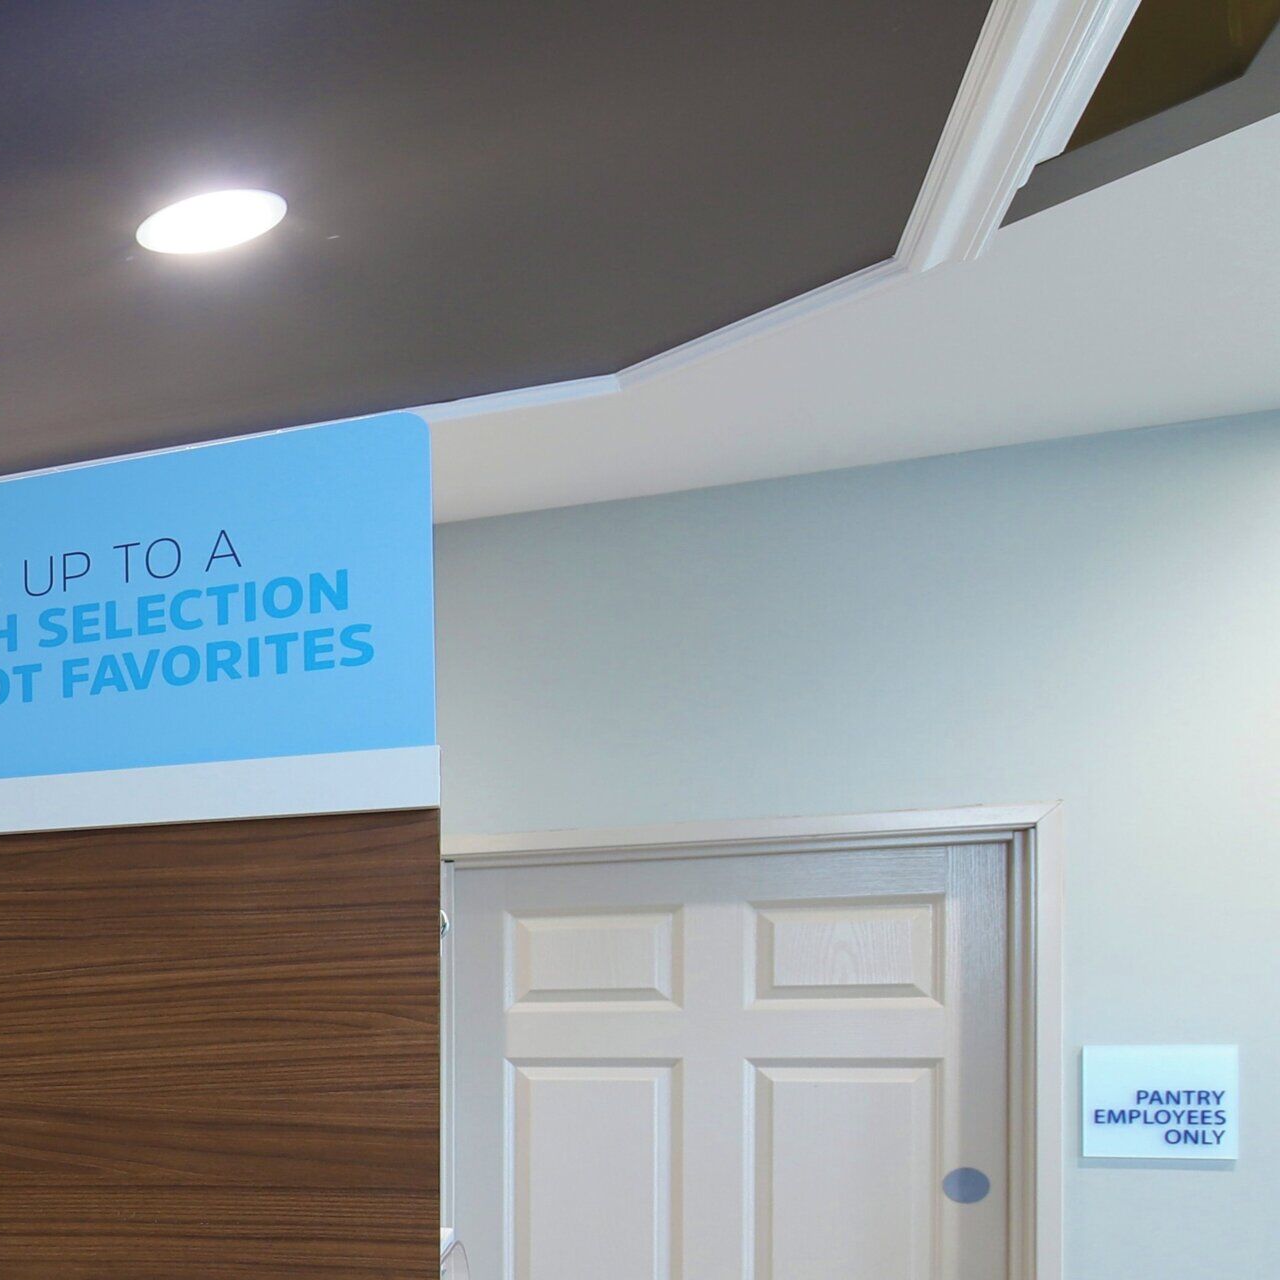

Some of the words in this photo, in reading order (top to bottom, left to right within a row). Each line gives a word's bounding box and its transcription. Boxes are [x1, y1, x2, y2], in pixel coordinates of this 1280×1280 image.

[23, 551, 92, 598] UP
[113, 537, 182, 583] TO
[204, 529, 243, 572] A
[38, 568, 350, 648] SELECTION
[62, 622, 375, 699] FAVORITES
[1093, 1108, 1227, 1126] EMPLOYEES
[1135, 1089, 1227, 1106] PANTRY
[1163, 1129, 1227, 1146] ONLY
